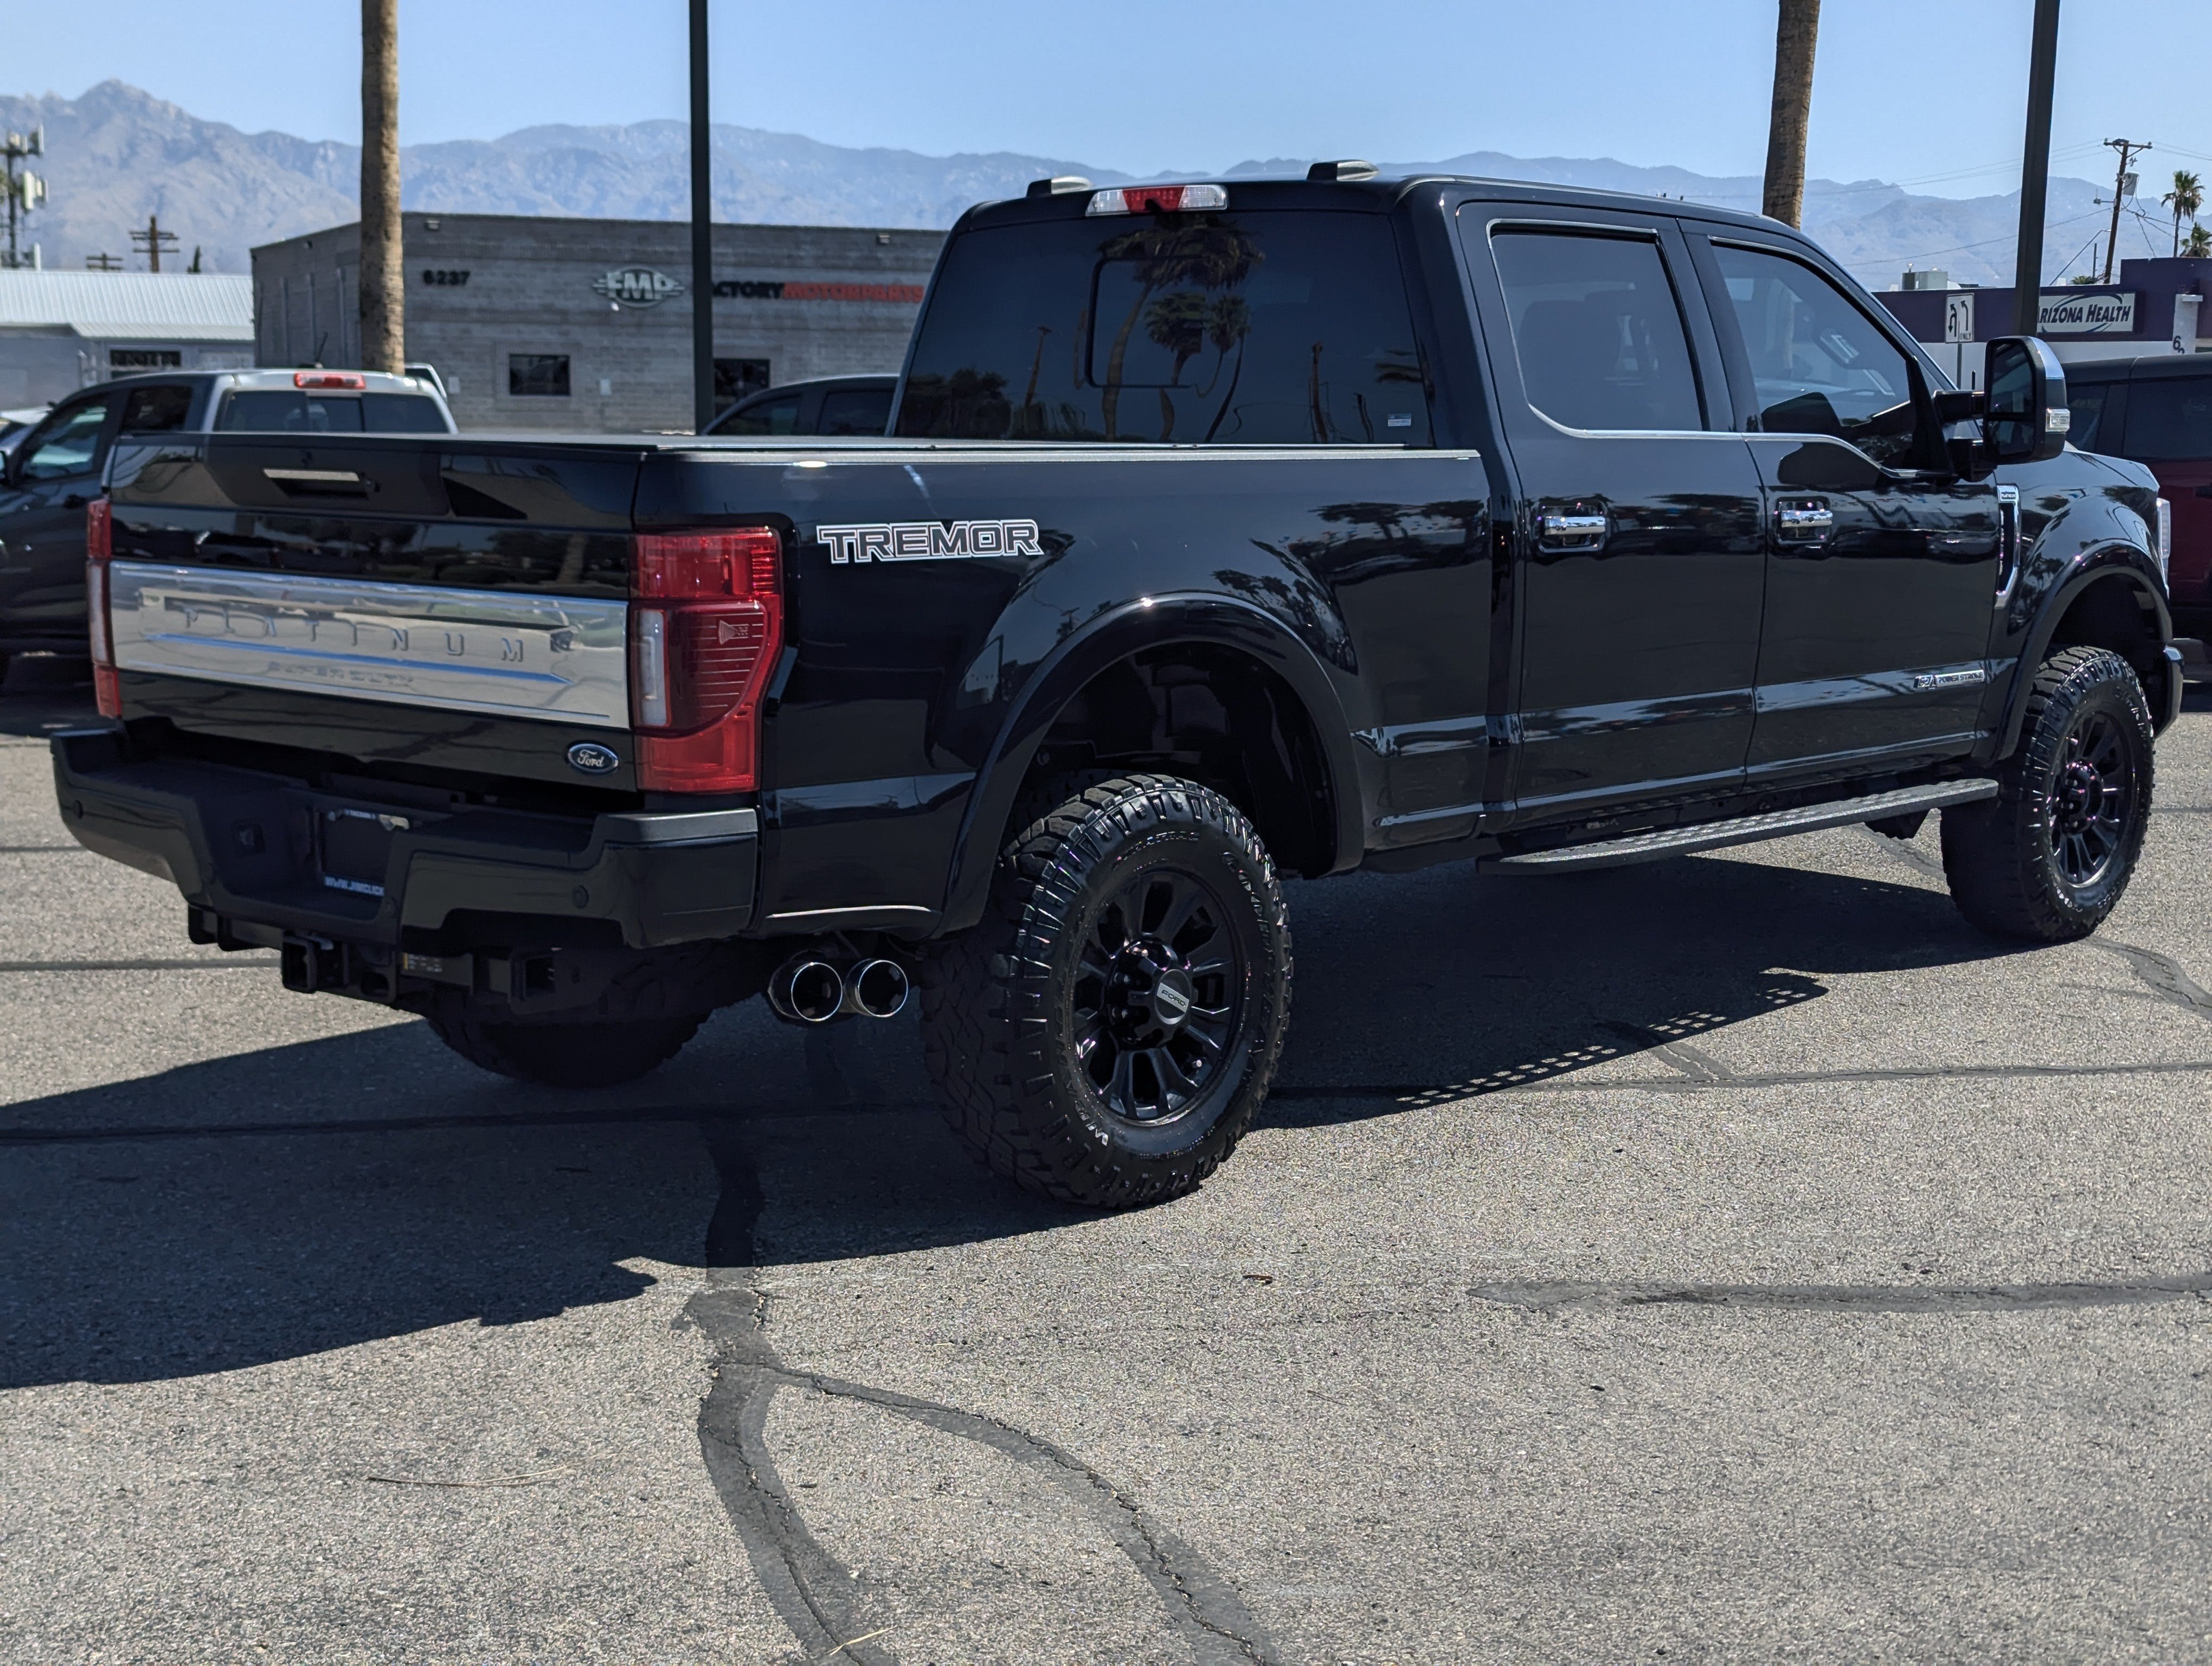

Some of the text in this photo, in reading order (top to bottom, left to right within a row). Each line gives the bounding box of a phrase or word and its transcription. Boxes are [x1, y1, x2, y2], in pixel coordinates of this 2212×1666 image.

[423, 270, 471, 285] 6237
[607, 272, 674, 299] FMP
[712, 281, 785, 299] CTORY
[2086, 304, 2131, 323] HEALTH
[816, 519, 1044, 564] TREMOR
[184, 607, 524, 663] PLATINUM
[577, 749, 605, 767] Ford
[1161, 989, 1186, 1007] FORD
